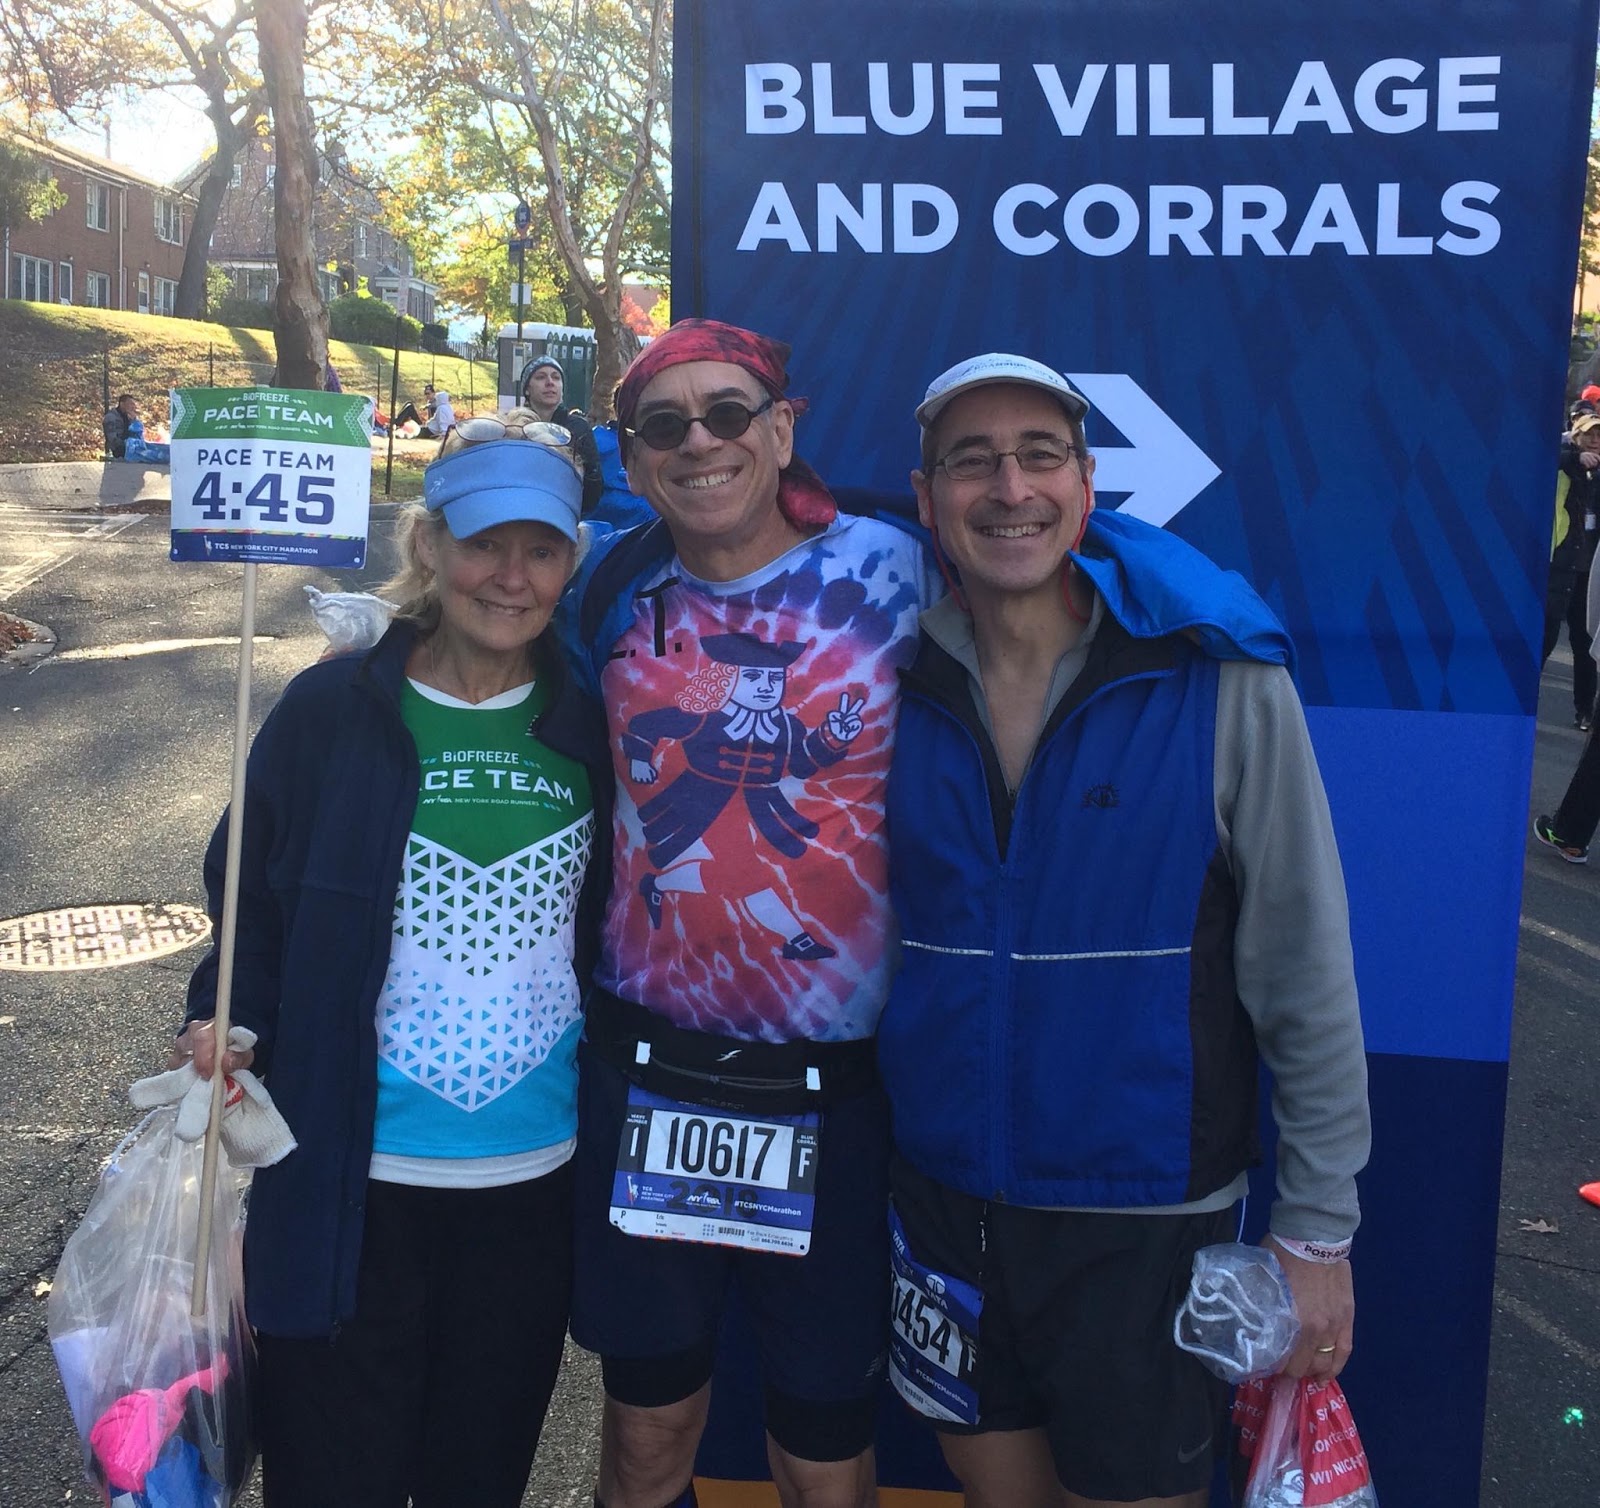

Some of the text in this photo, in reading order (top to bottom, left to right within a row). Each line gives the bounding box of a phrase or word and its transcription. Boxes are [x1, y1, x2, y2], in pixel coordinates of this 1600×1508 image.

[745, 56, 1502, 136] BLUE VILLAGE
[736, 180, 1501, 256] AND CORRALS
[203, 404, 258, 423] PACE
[265, 405, 334, 429] TEAM
[197, 448, 334, 471] PACE TEAM
[192, 471, 335, 525] 4:45
[279, 546, 318, 554] MARATHON
[419, 768, 575, 806] CE TEAM
[665, 1116, 777, 1181] 10617
[797, 1147, 813, 1178] F
[734, 1200, 802, 1216] #TCSNYCMarathon
